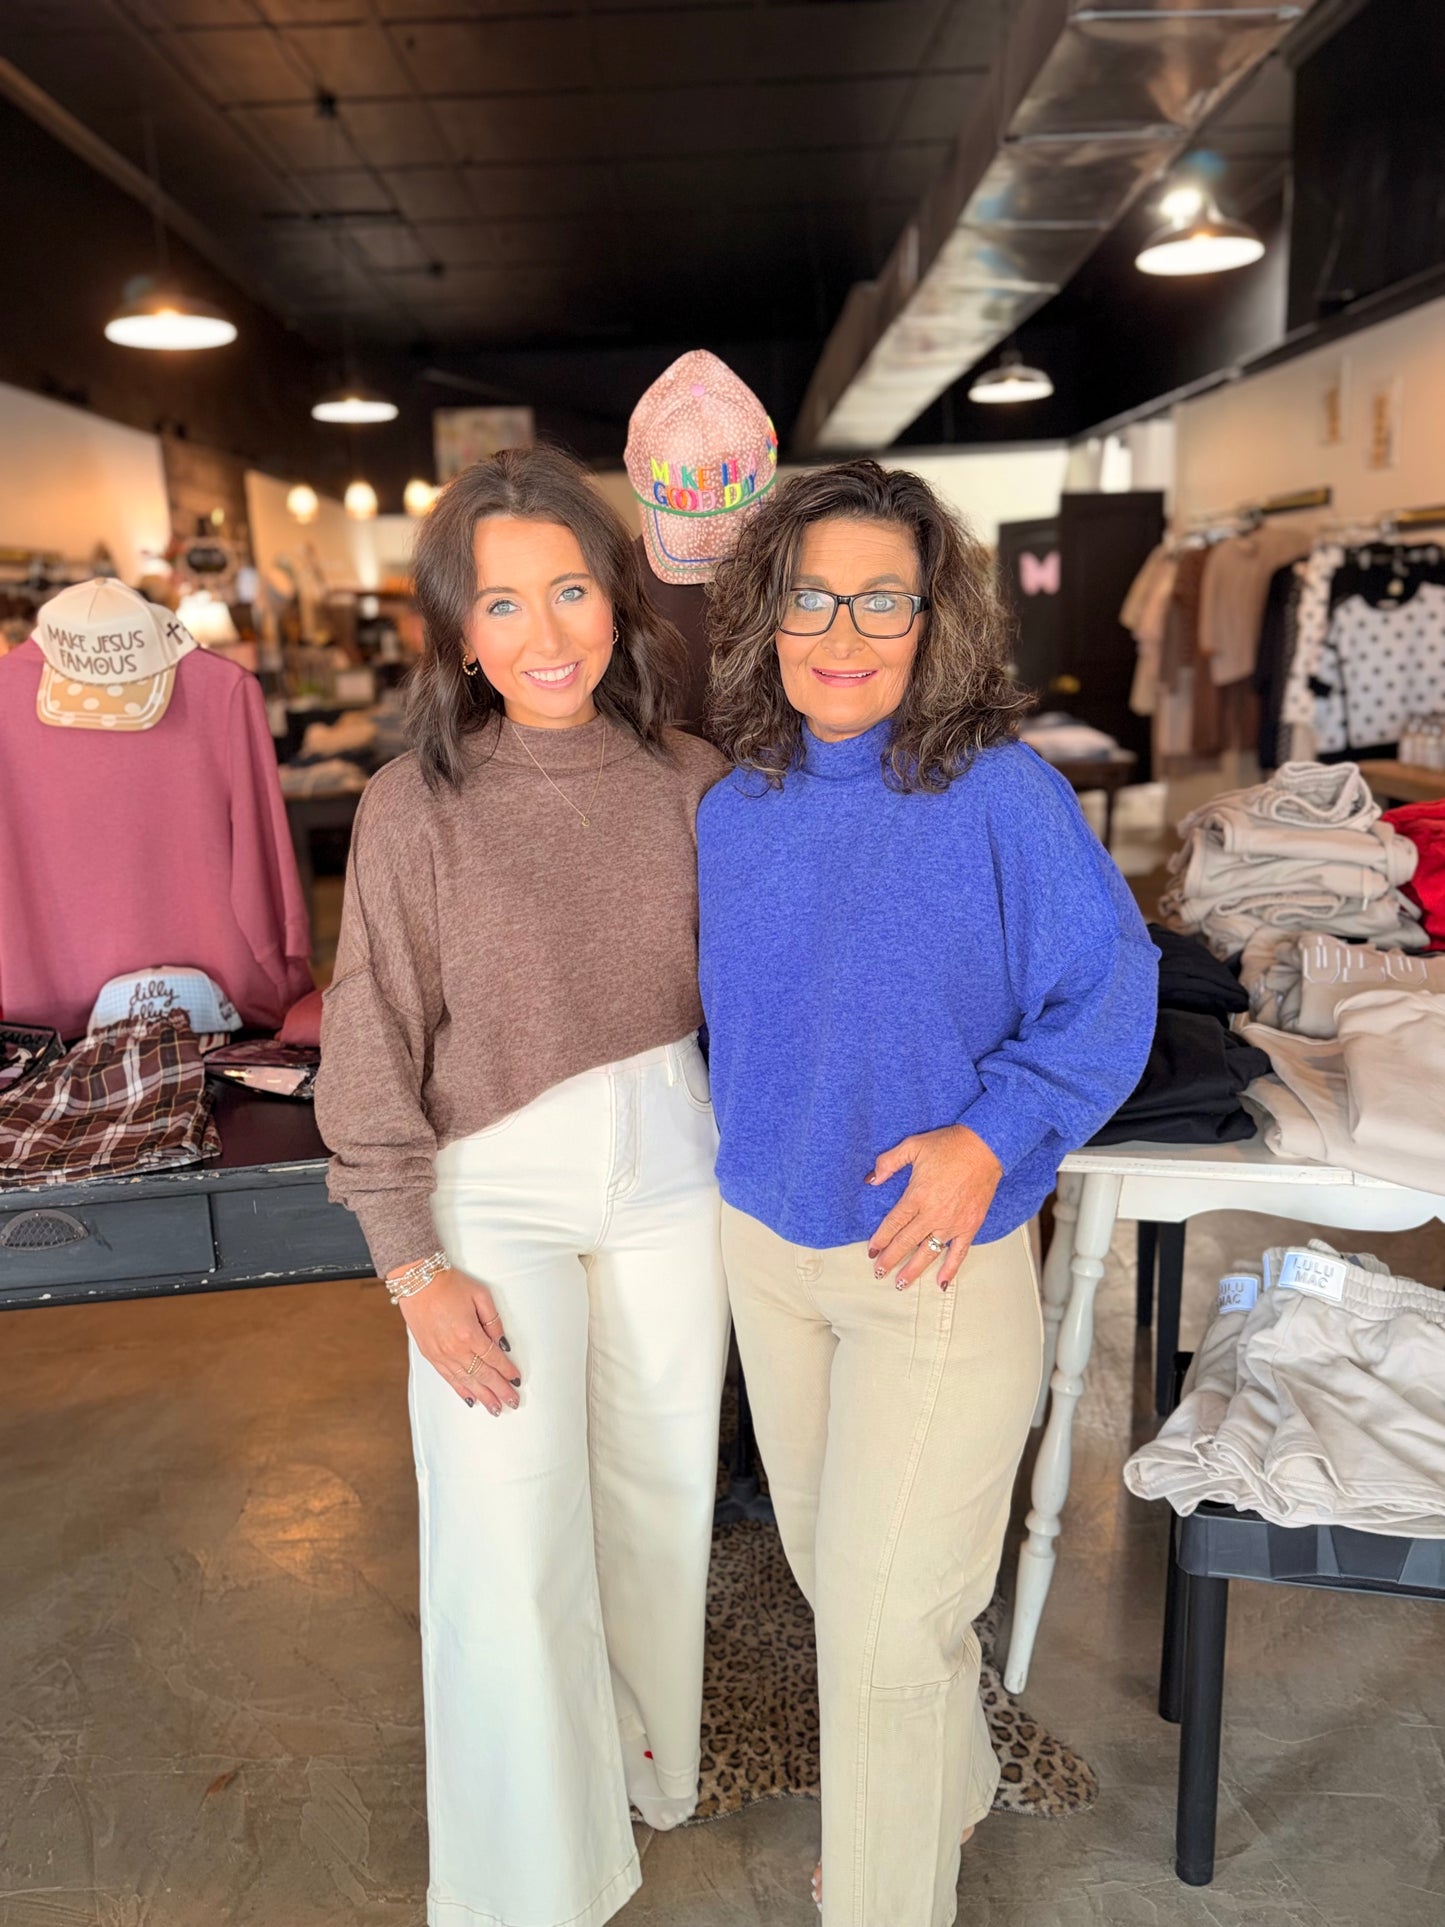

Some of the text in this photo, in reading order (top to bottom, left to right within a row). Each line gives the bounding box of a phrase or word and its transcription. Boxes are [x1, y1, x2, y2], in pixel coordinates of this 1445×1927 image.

[650, 456, 715, 491] MAKE
[722, 459, 738, 487] IT
[653, 469, 757, 512] GOOD DAY
[47, 624, 145, 654] MAKE JESUS
[60, 649, 137, 675] FAMOUS
[1293, 1257, 1335, 1277] LULU
[1295, 1270, 1328, 1288] MAC
